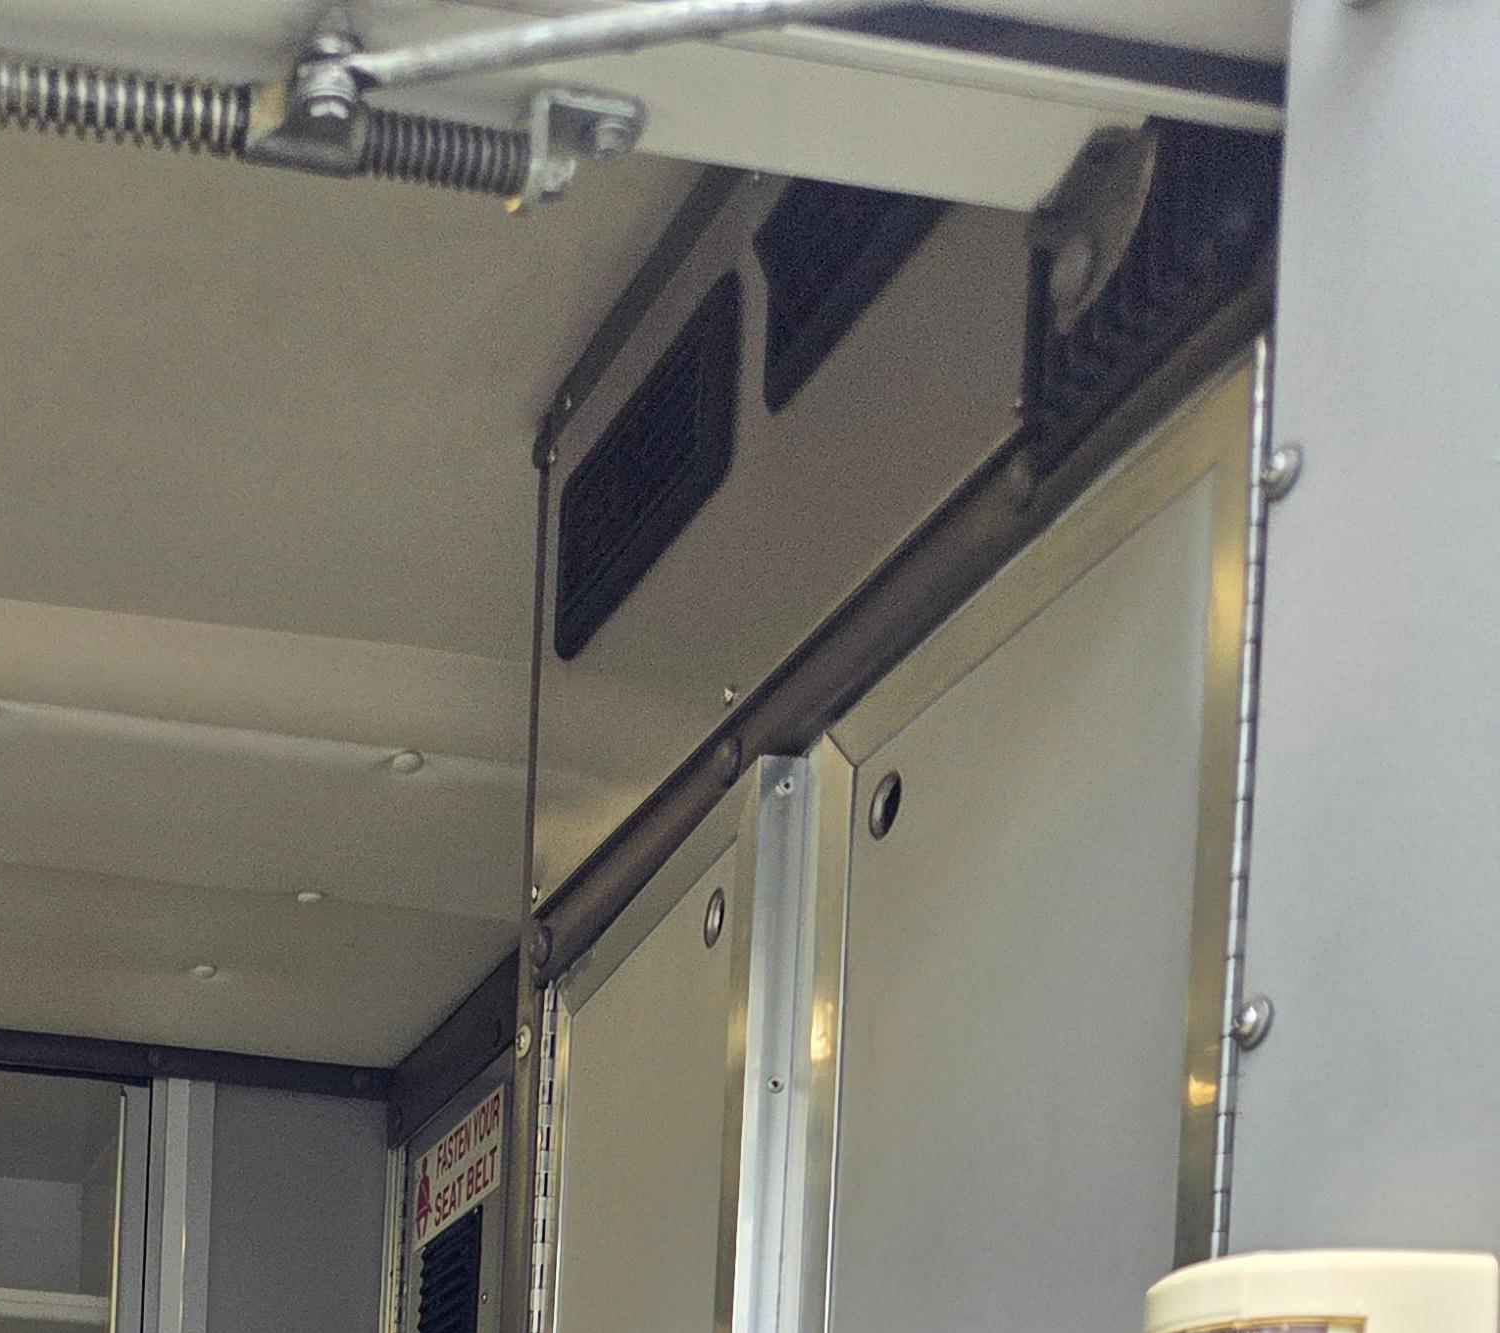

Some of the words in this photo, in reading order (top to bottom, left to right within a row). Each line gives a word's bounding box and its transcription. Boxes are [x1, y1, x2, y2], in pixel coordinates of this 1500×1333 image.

[436, 1117, 472, 1180] FASTEN
[473, 1093, 500, 1147] YOUR
[434, 1173, 465, 1227] SEAT
[466, 1145, 498, 1201] BELT
